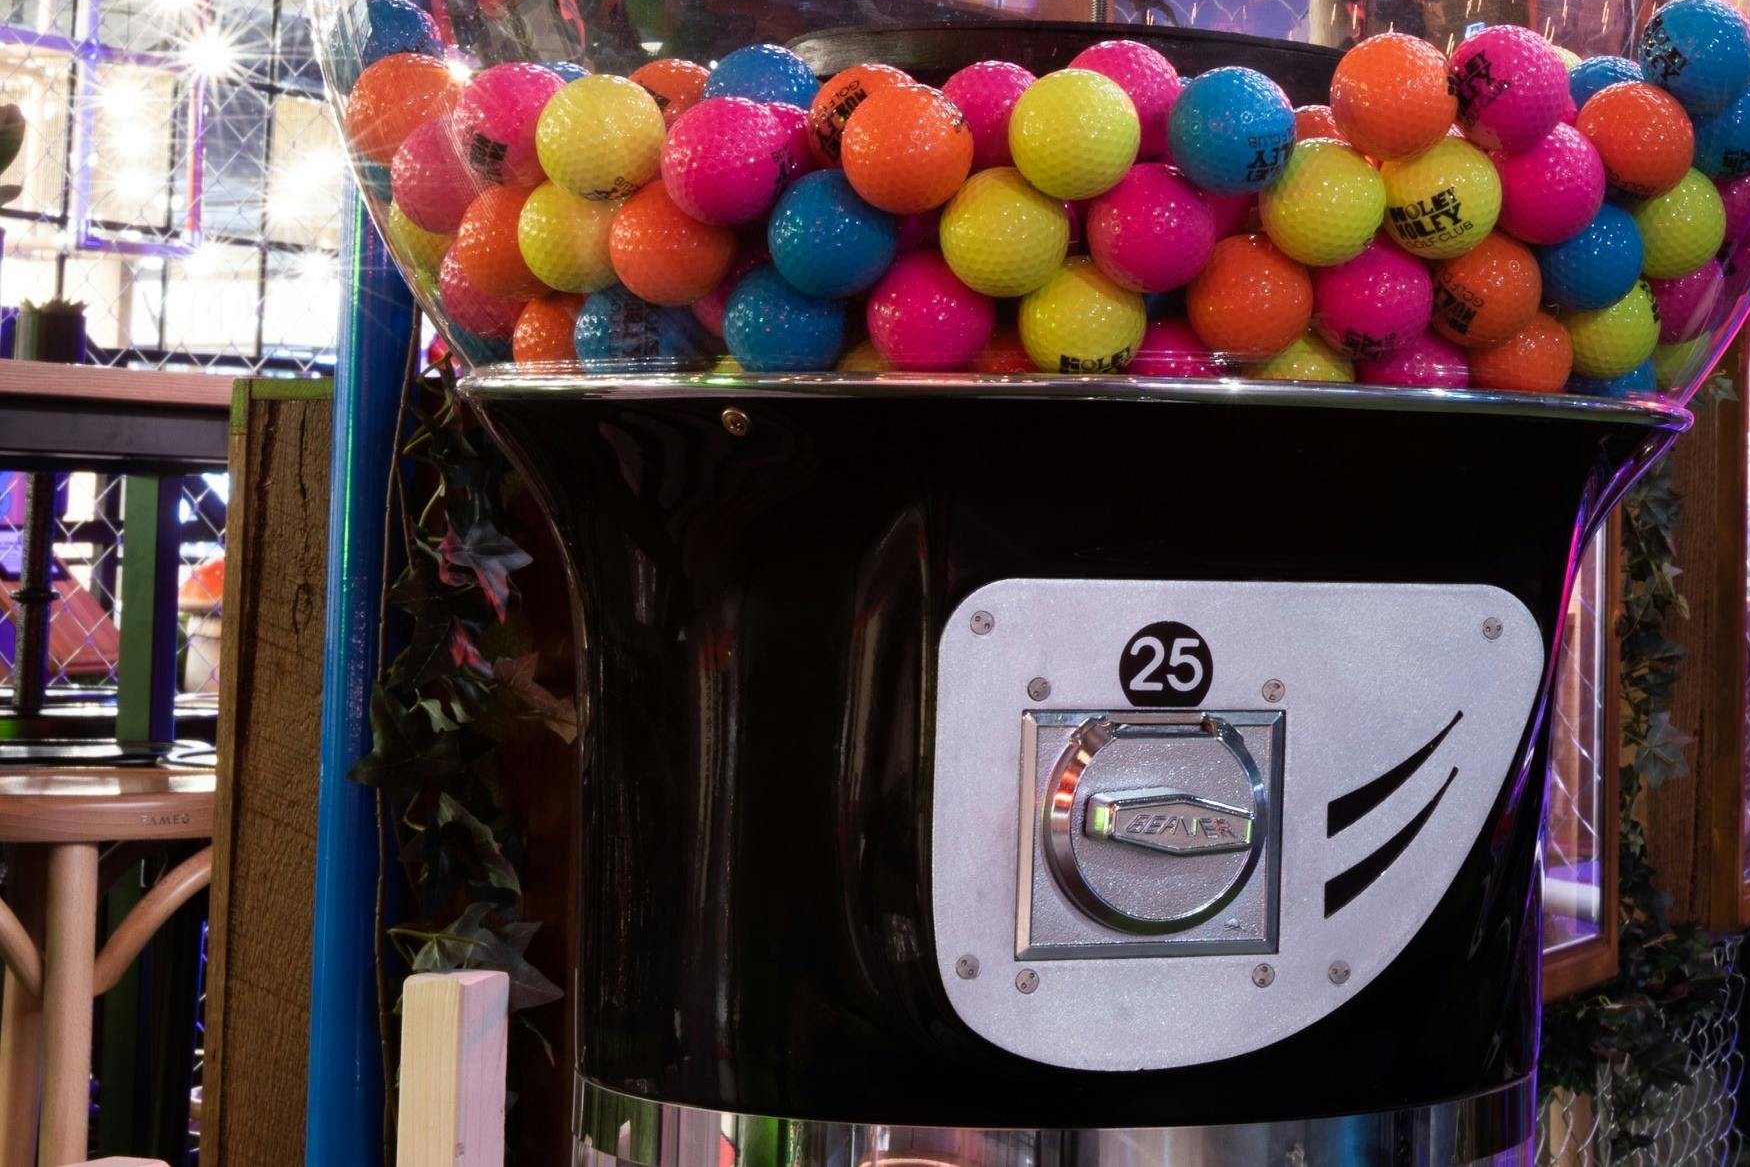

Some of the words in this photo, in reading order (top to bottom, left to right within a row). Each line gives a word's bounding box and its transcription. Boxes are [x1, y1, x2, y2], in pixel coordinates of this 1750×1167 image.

[1438, 220, 1475, 243] CLUB
[1128, 636, 1205, 693] 25
[1125, 813, 1237, 840] BEAVER
